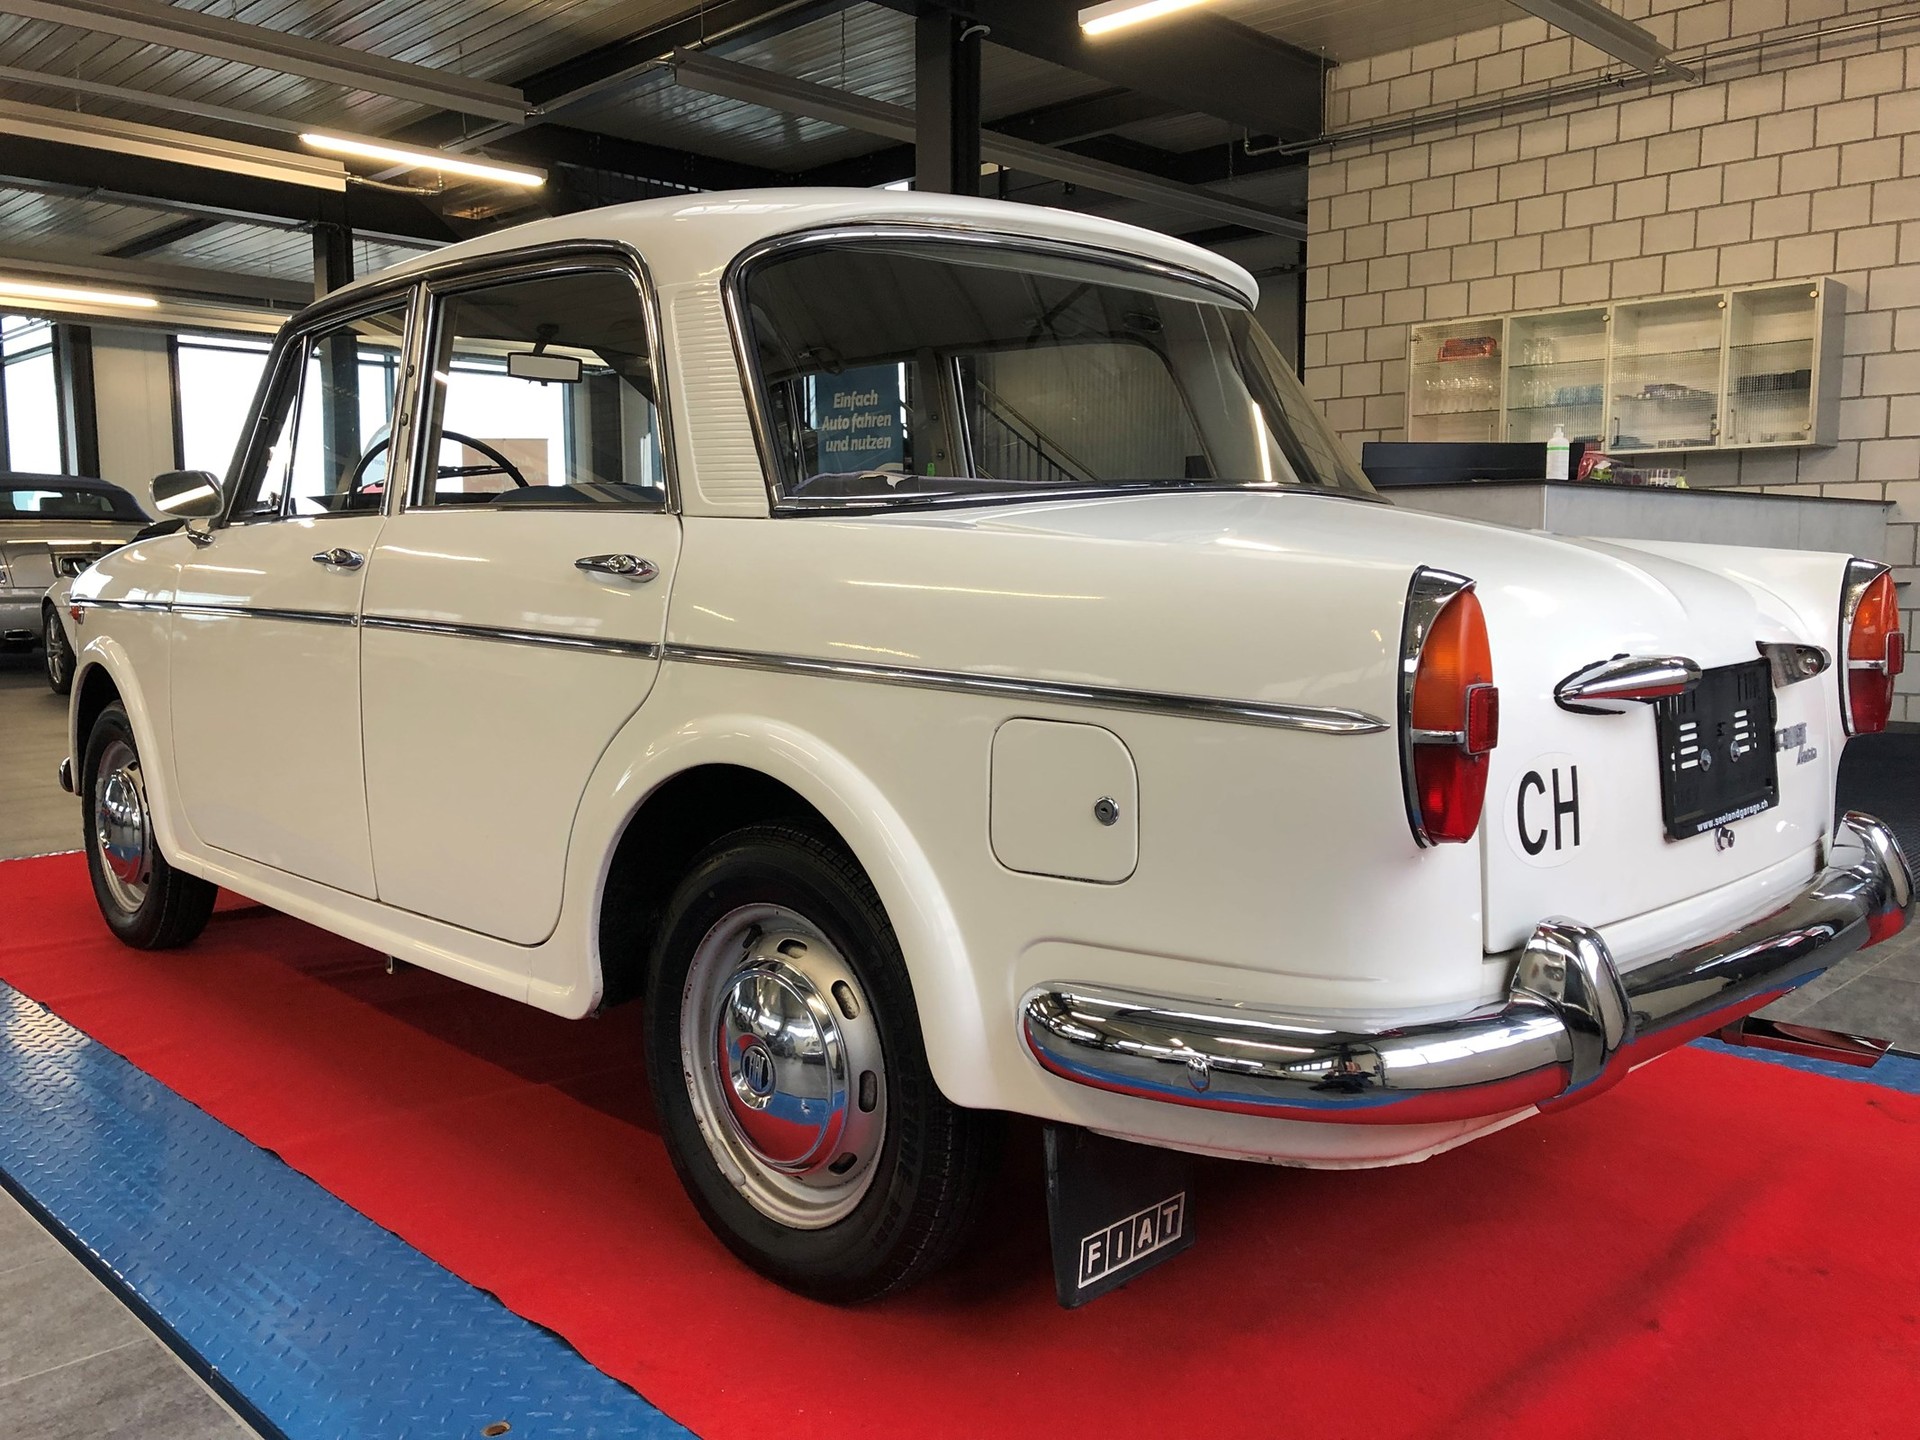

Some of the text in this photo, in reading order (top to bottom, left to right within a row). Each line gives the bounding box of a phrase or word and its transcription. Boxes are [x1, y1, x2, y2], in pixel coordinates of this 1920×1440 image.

[833, 389, 879, 411] Einfach
[821, 412, 892, 433] Auto fahren
[825, 434, 892, 453] und nutzen
[1516, 764, 1581, 856] CH
[1696, 799, 1769, 833] www.seelandgarage.ch
[1087, 1203, 1179, 1274] FIAT
